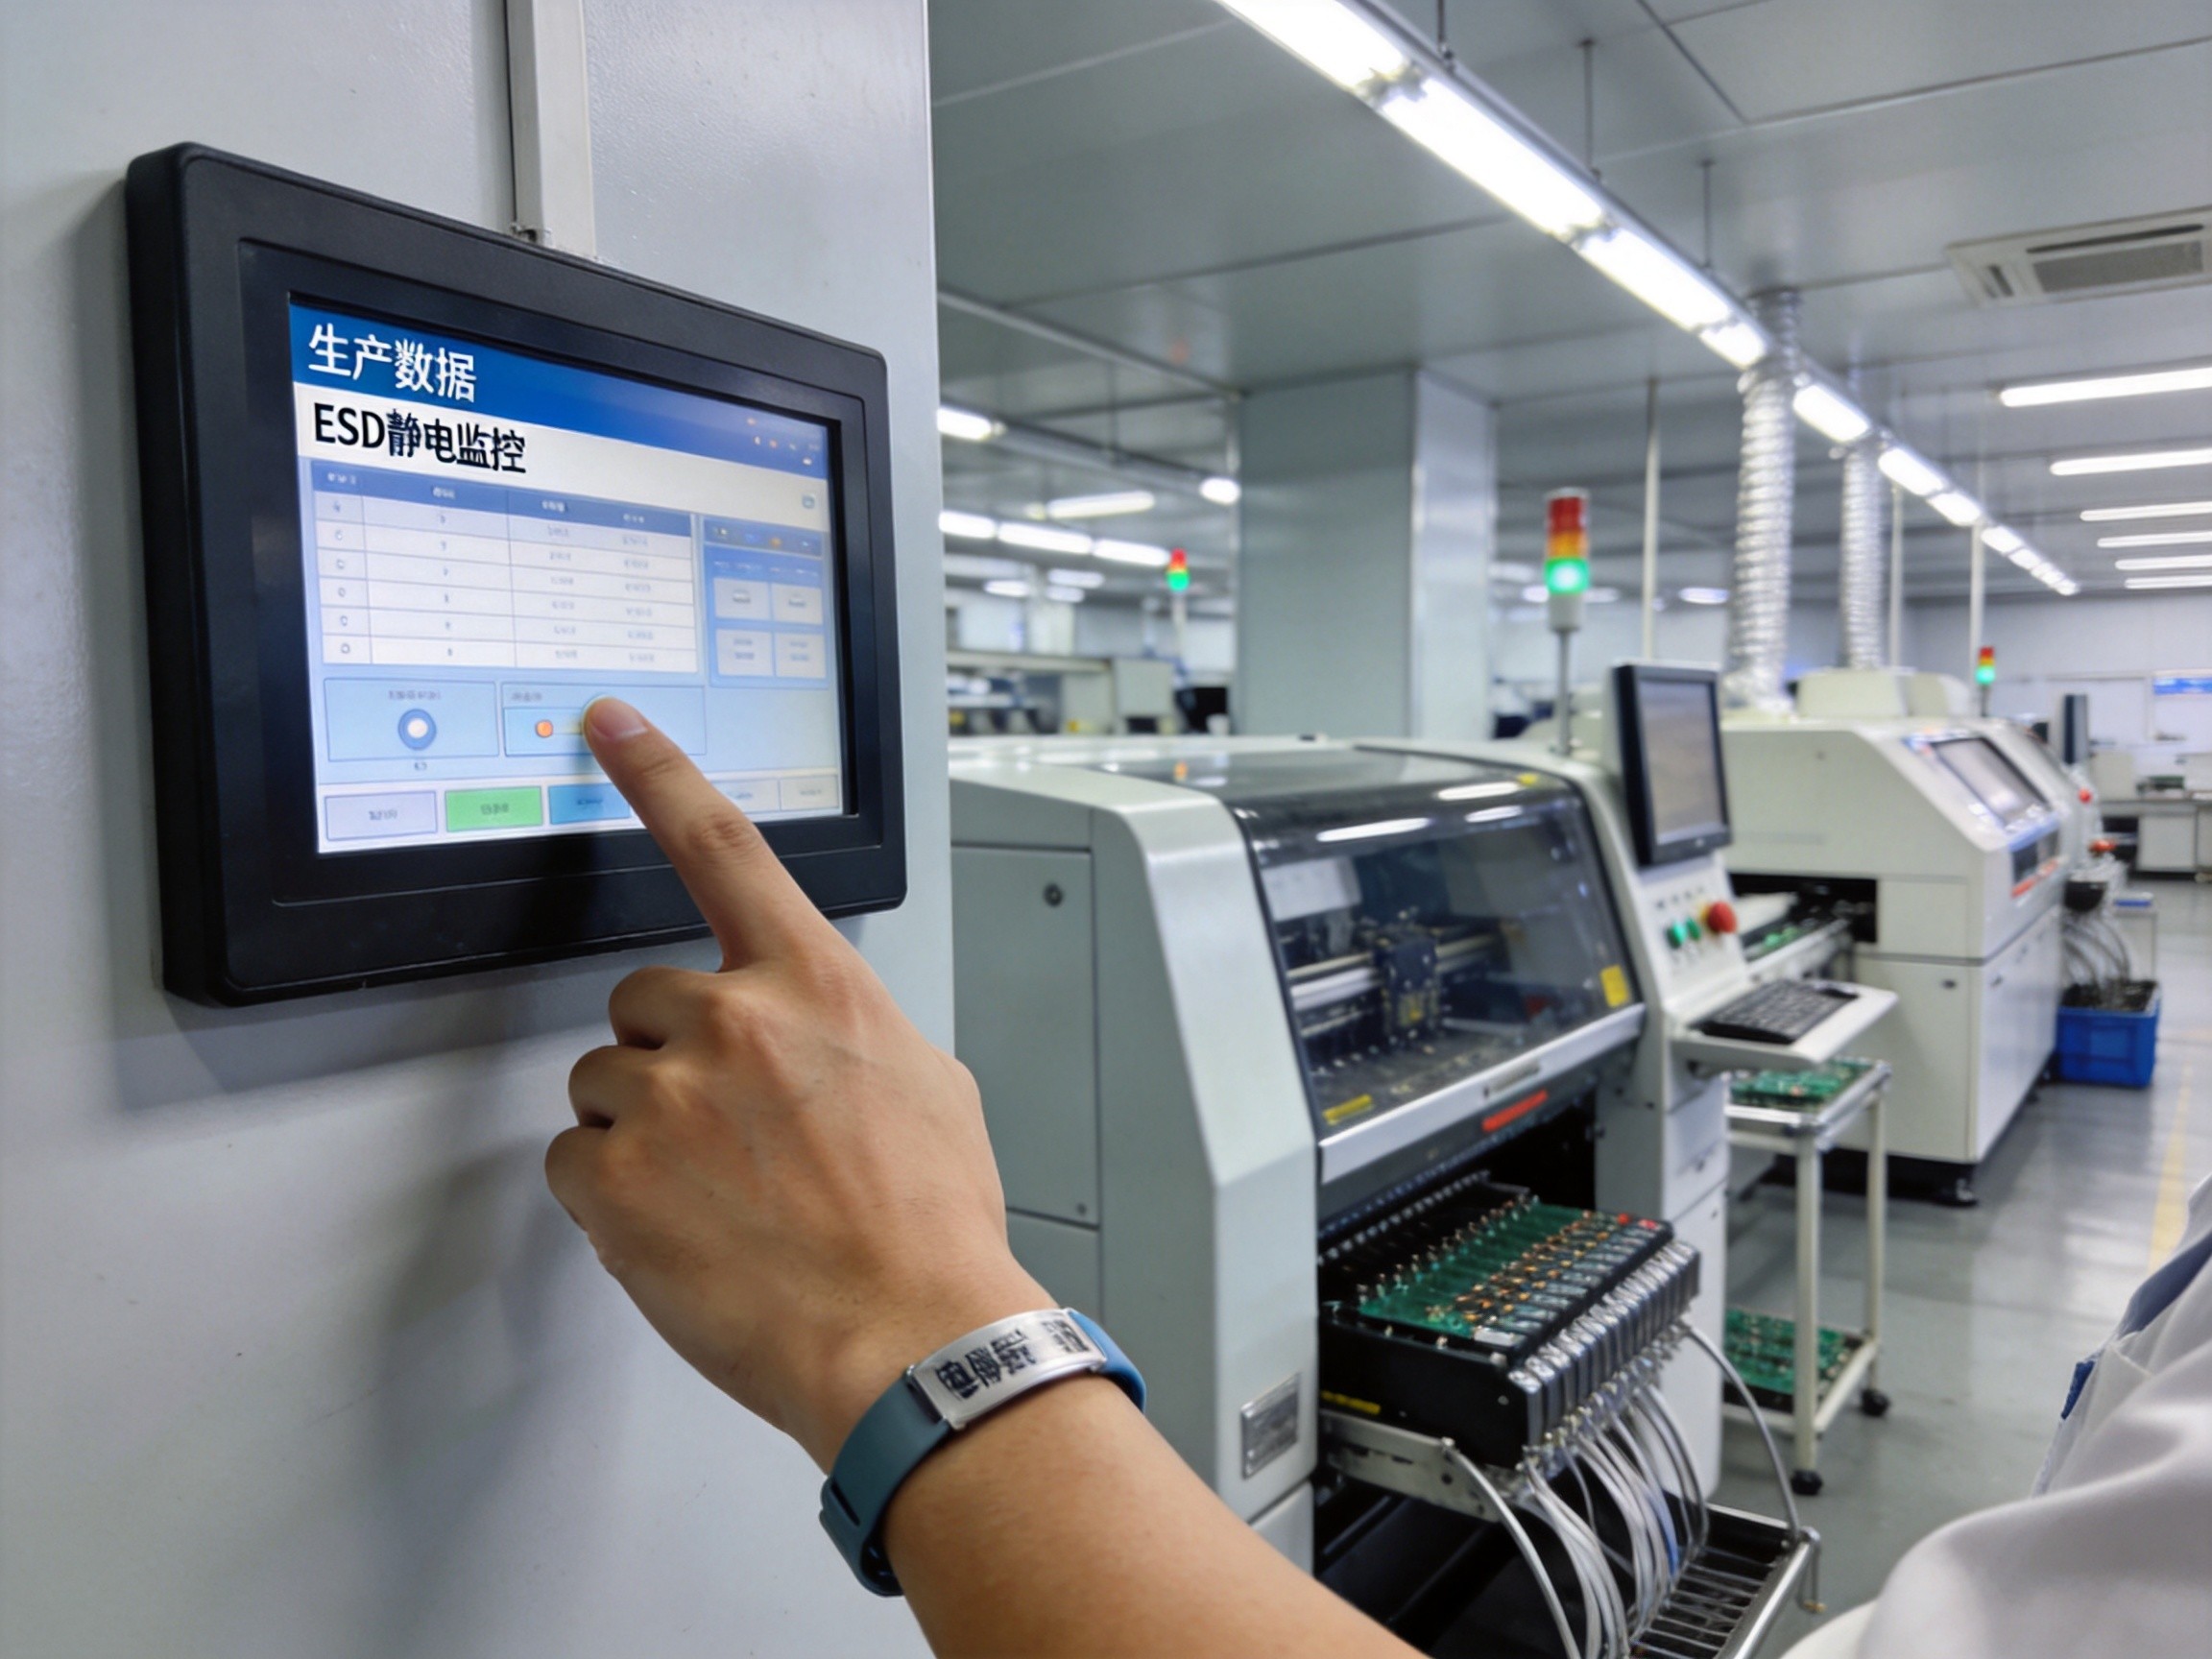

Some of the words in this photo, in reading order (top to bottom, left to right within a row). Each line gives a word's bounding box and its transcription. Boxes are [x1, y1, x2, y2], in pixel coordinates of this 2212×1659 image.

[308, 323, 476, 402] 生产数据
[314, 402, 526, 473] ESD静电监控
